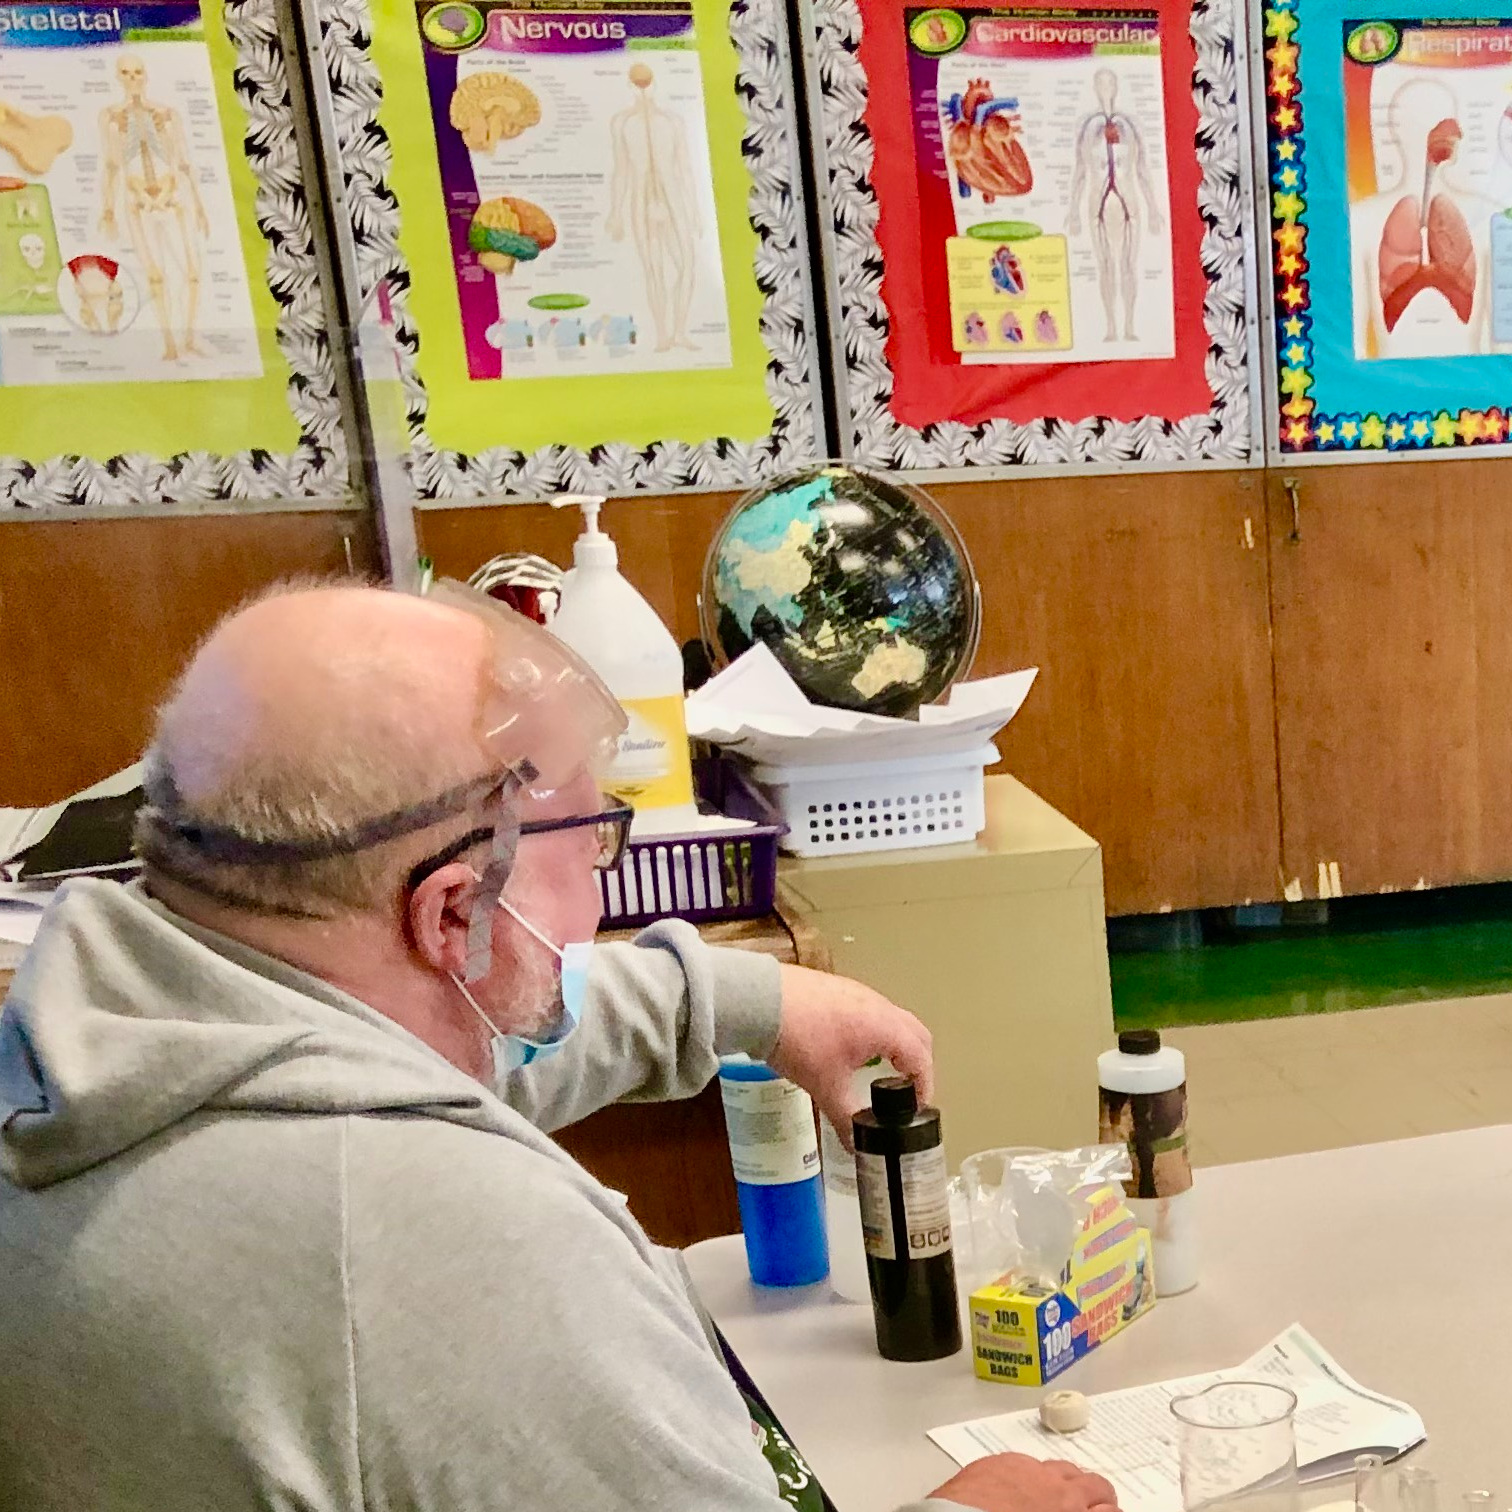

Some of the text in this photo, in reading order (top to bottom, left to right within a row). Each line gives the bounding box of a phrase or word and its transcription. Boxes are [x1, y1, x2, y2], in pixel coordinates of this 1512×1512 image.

[0, 7, 121, 31] Skeletal
[500, 15, 627, 44] Nervous
[976, 22, 1159, 45] Cardiovascular
[994, 1309, 1020, 1326] 100
[1071, 1281, 1134, 1338] SANDWICH
[1043, 1322, 1072, 1361] 100
[976, 1345, 1033, 1366] SANDWICH
[990, 1363, 1019, 1379] BAGS
